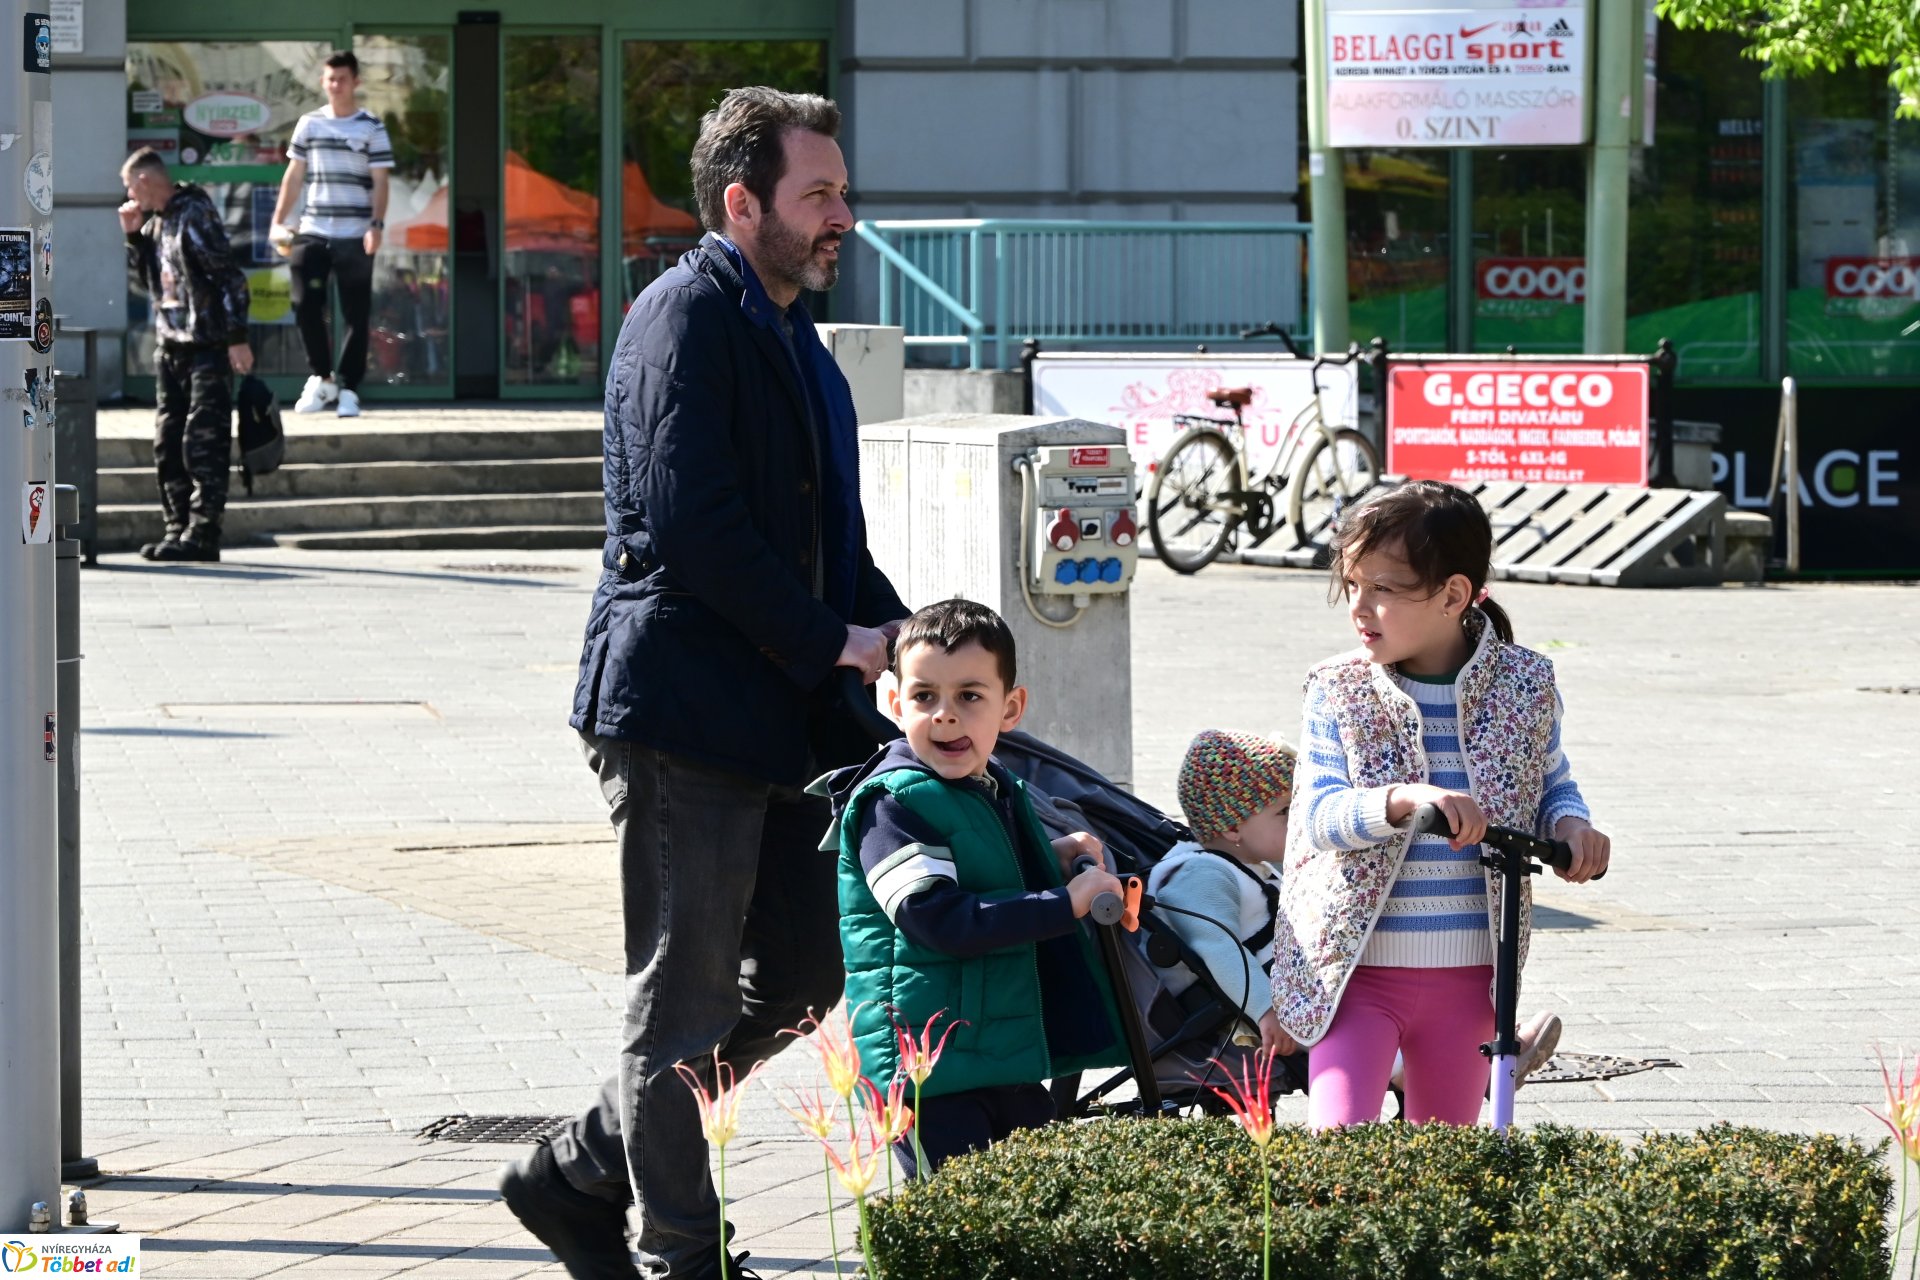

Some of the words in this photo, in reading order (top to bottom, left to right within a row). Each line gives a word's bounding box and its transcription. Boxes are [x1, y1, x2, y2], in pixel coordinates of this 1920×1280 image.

[1332, 33, 1454, 62] BELAGGI
[1466, 39, 1565, 64] sport
[1424, 116, 1500, 139] SZINT
[1423, 374, 1613, 407] G.GECCO
[1451, 406, 1495, 425] FÉRFI
[1498, 406, 1584, 425] DIVATÁRU
